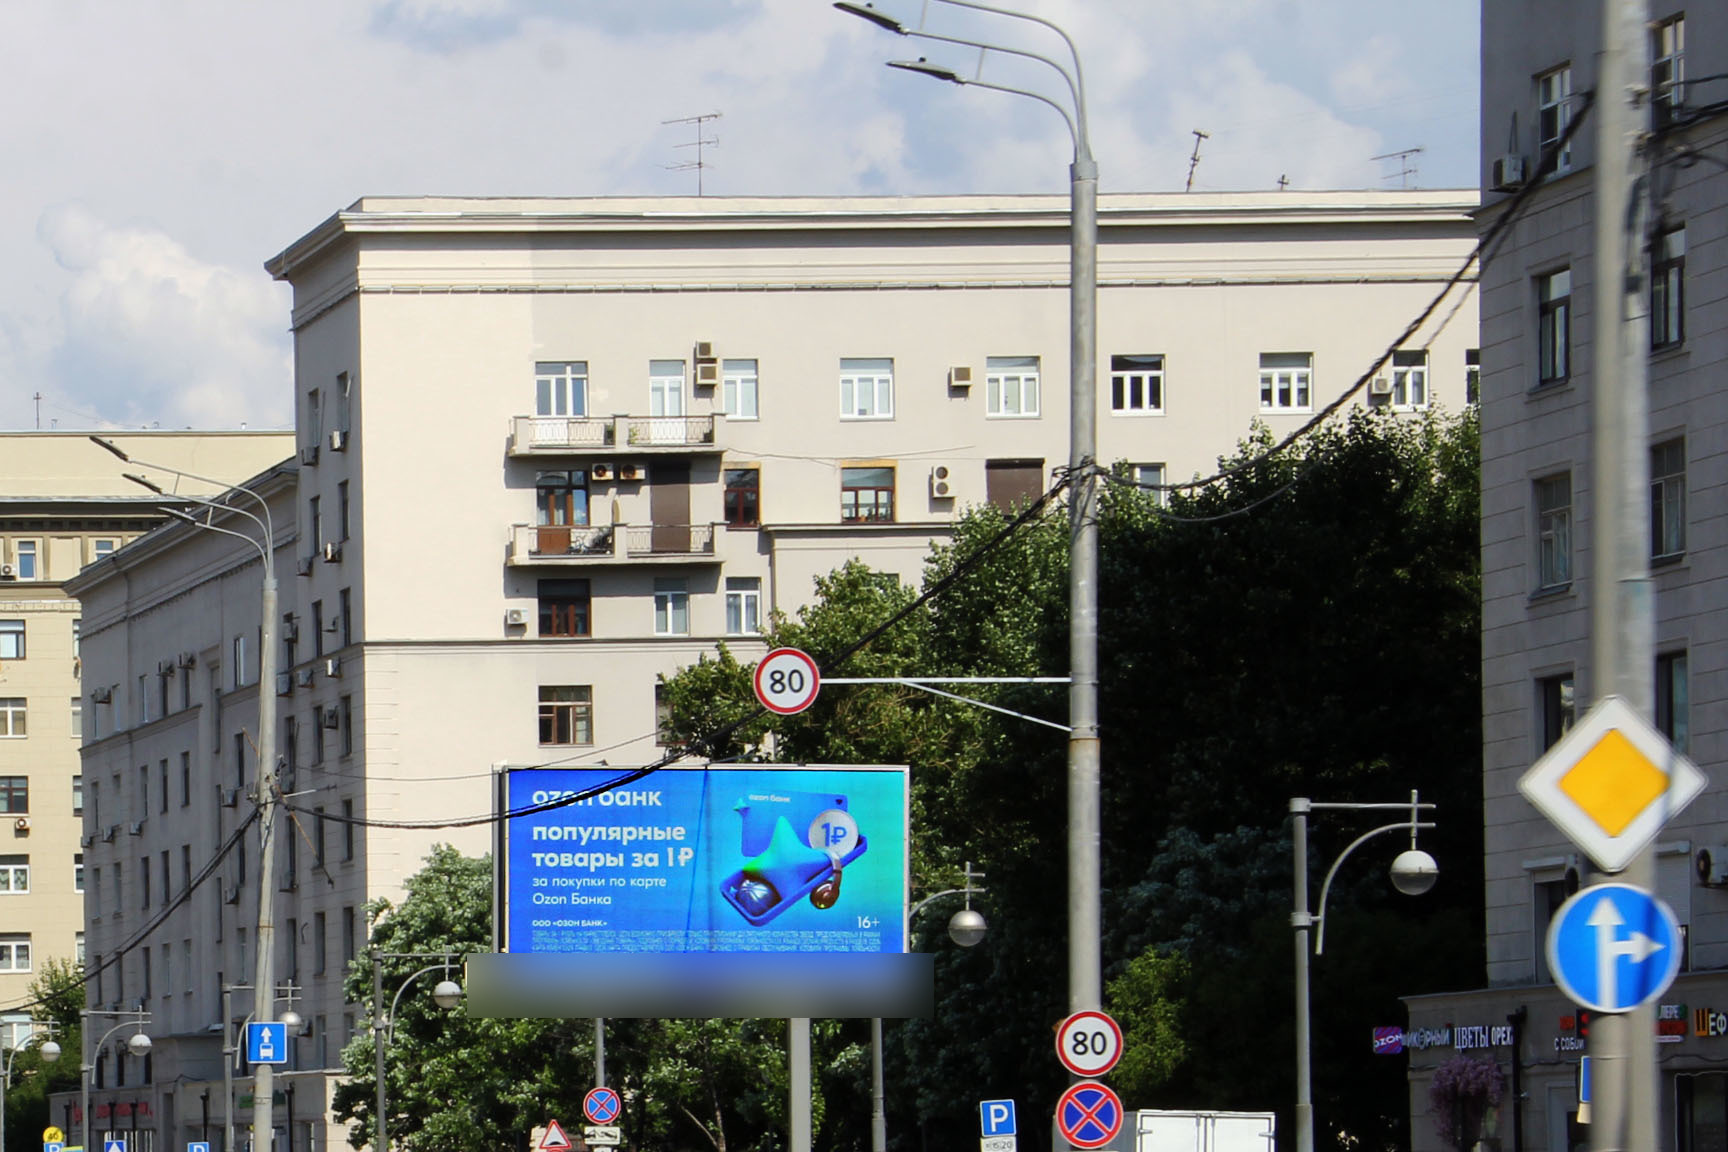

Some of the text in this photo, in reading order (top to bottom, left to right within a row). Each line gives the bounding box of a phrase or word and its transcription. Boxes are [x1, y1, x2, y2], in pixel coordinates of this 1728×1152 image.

[769, 669, 804, 693] 80
[597, 791, 662, 806] банк
[532, 826, 686, 846] популярные
[532, 852, 624, 872] товары
[631, 853, 659, 867] за
[532, 877, 667, 889] за покупки по карте
[532, 892, 612, 905] Ozon Банка
[857, 916, 880, 928] 16+
[1073, 1031, 1107, 1055] 80
[1454, 1026, 1489, 1053] ЦВЕТЫ
[1491, 1026, 1513, 1046] ОРЕХ
